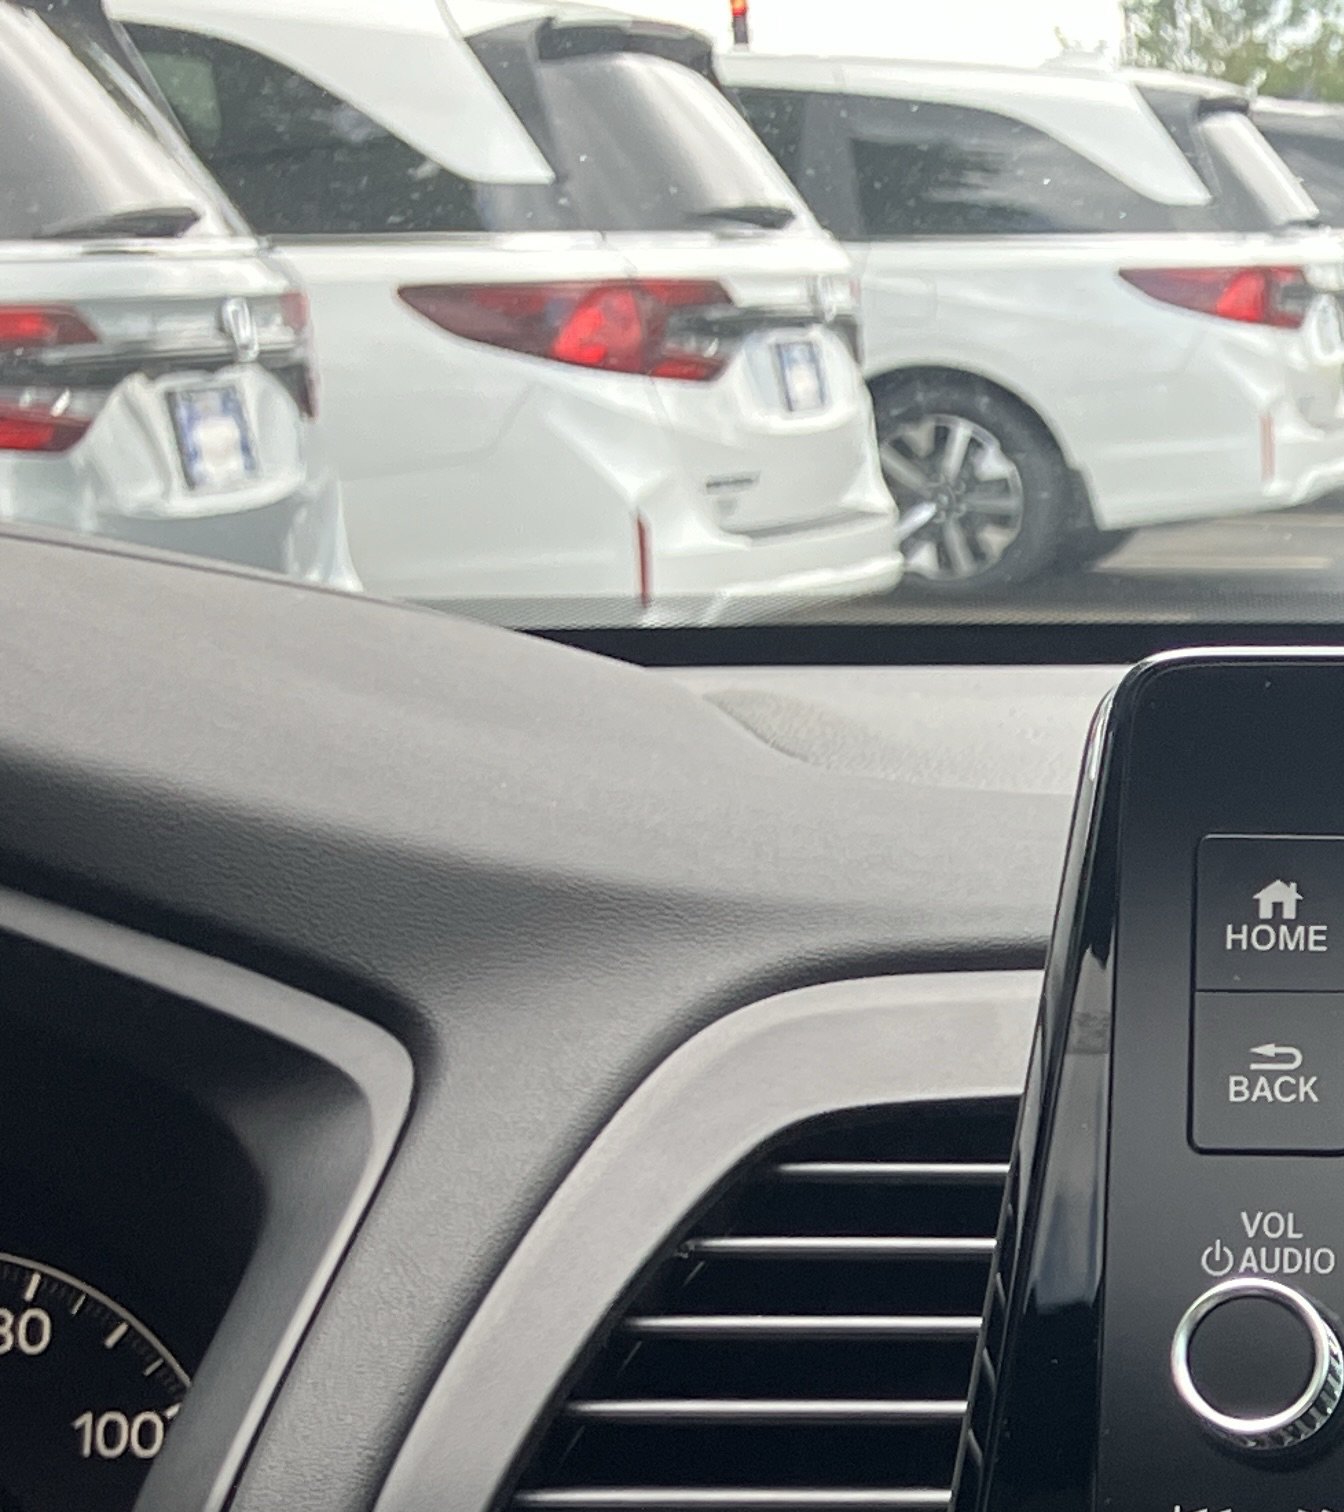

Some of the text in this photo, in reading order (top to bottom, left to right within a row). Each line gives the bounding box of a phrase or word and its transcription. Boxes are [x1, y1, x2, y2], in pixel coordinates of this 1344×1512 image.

[1225, 924, 1329, 952] HOME
[1227, 1075, 1320, 1103] BACK
[1240, 1211, 1304, 1239] VOL
[1238, 1246, 1336, 1275] AUDIO
[71, 1410, 165, 1458] 100
